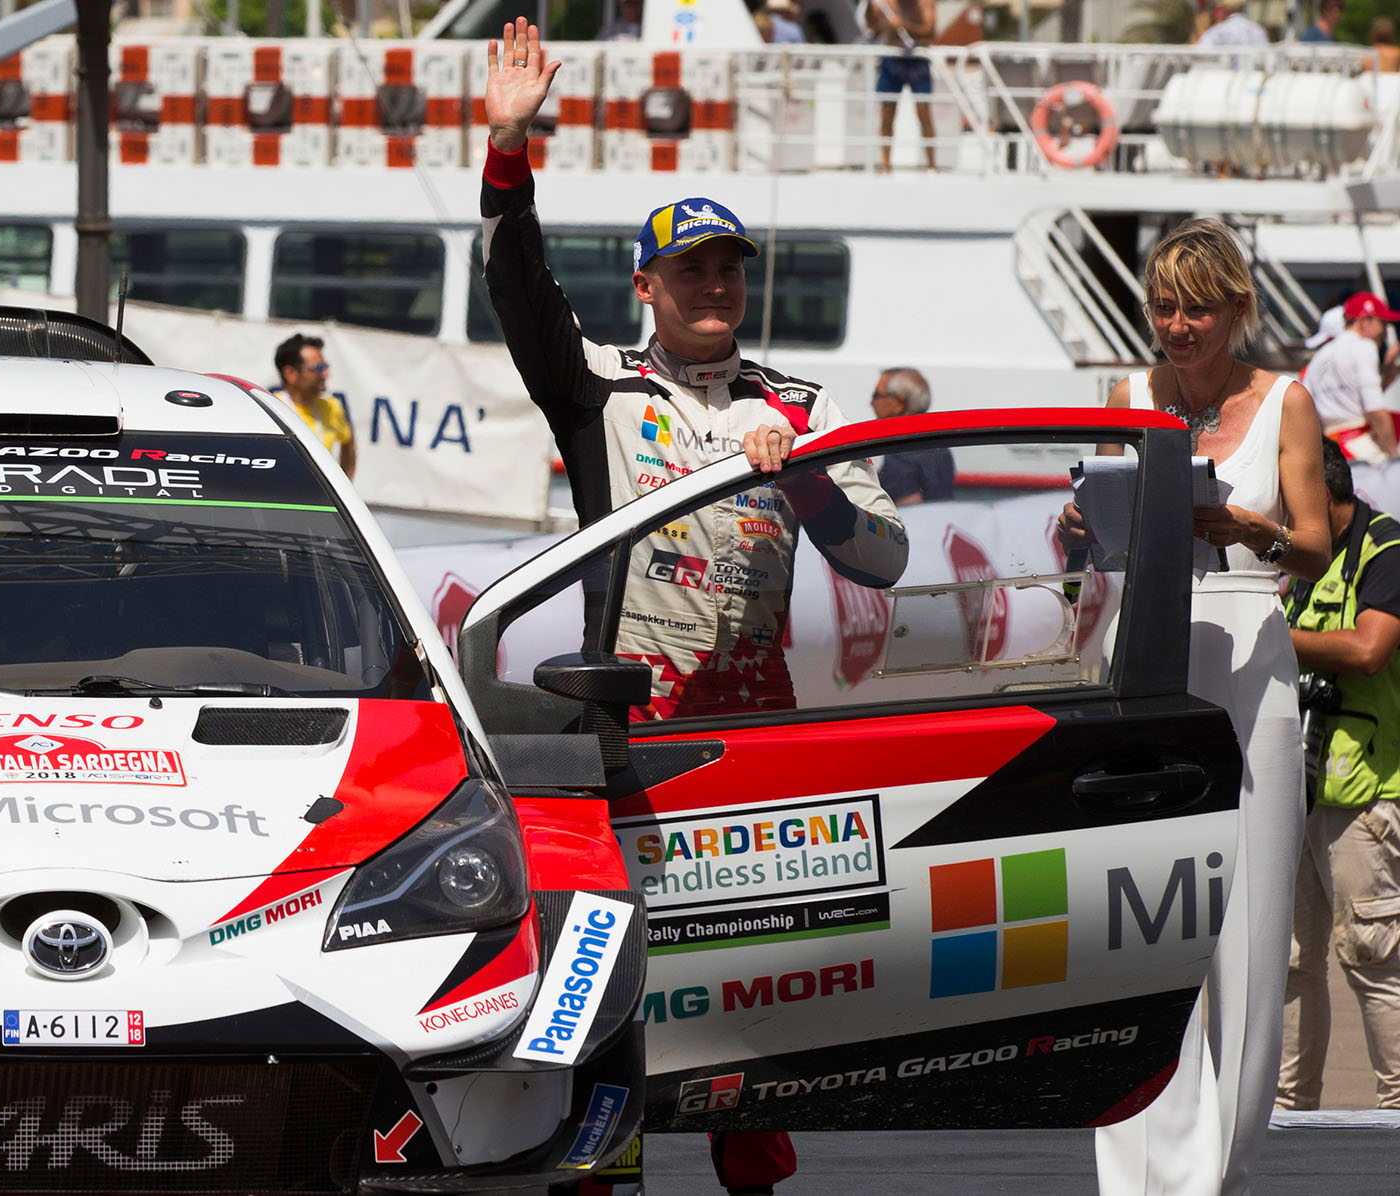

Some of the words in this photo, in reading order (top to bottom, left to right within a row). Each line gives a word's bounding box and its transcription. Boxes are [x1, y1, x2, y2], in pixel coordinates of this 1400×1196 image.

[677, 217, 736, 234] MICHELIN
[778, 390, 808, 403] OMP
[677, 427, 743, 455] Micro
[130, 448, 277, 469] Racing
[635, 453, 665, 467] DMG
[735, 493, 774, 511] Mobil
[655, 526, 688, 540] SSE
[743, 522, 780, 537] MOILAS
[647, 561, 702, 590] GR
[713, 562, 769, 581] TOYOTA
[619, 608, 665, 627] Esapekka
[56, 751, 173, 773] SARDEGNA
[25, 771, 78, 780] 2018
[636, 811, 870, 865] SARDEGNA
[641, 861, 766, 897] endless
[775, 842, 873, 882] island
[209, 915, 263, 946] DMG
[264, 888, 324, 925] MORI
[686, 913, 795, 939] Championship
[338, 918, 393, 942] PIAA
[527, 908, 617, 1056] Panasonic
[721, 959, 875, 1013] MORI
[128, 1013, 142, 1026] 12
[419, 991, 519, 1033] KONECRANES
[5, 1028, 20, 1039] FIN
[25, 1014, 120, 1039] A-6112
[128, 1028, 142, 1042] 18
[679, 1087, 740, 1113] GR
[752, 1065, 887, 1101] TOYOTA
[897, 1044, 1018, 1079] GAZOO
[1026, 1025, 1140, 1057] Racing
[581, 1095, 615, 1155] MICHELIN
